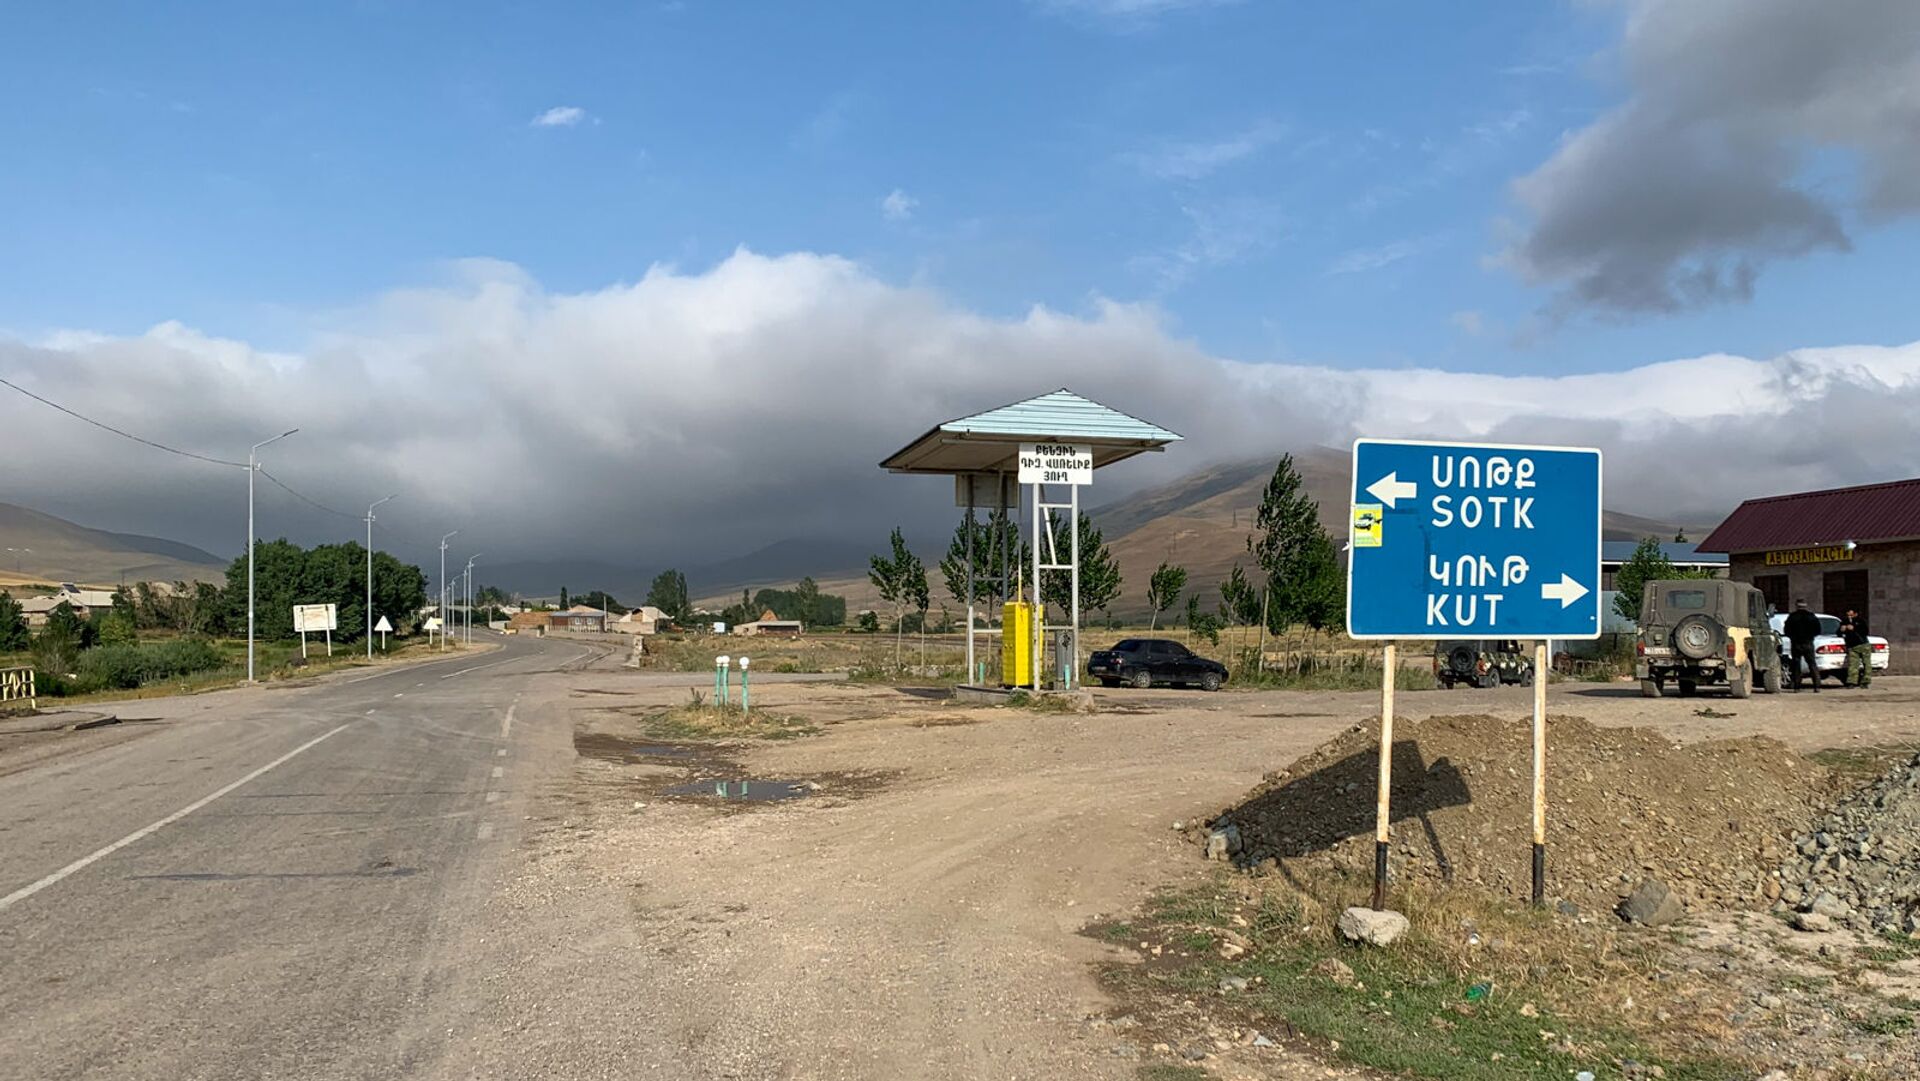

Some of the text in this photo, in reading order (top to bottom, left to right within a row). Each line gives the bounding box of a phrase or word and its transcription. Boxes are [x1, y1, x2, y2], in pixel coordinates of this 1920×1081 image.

[1432, 455, 1536, 489] ՍՈԹՔ
[1431, 495, 1535, 529] SOTK
[1429, 554, 1530, 587] ԿՈՒԹ
[1769, 546, 1850, 565] АВТОЗАПЧАСТИ
[1426, 594, 1504, 627] KUT
